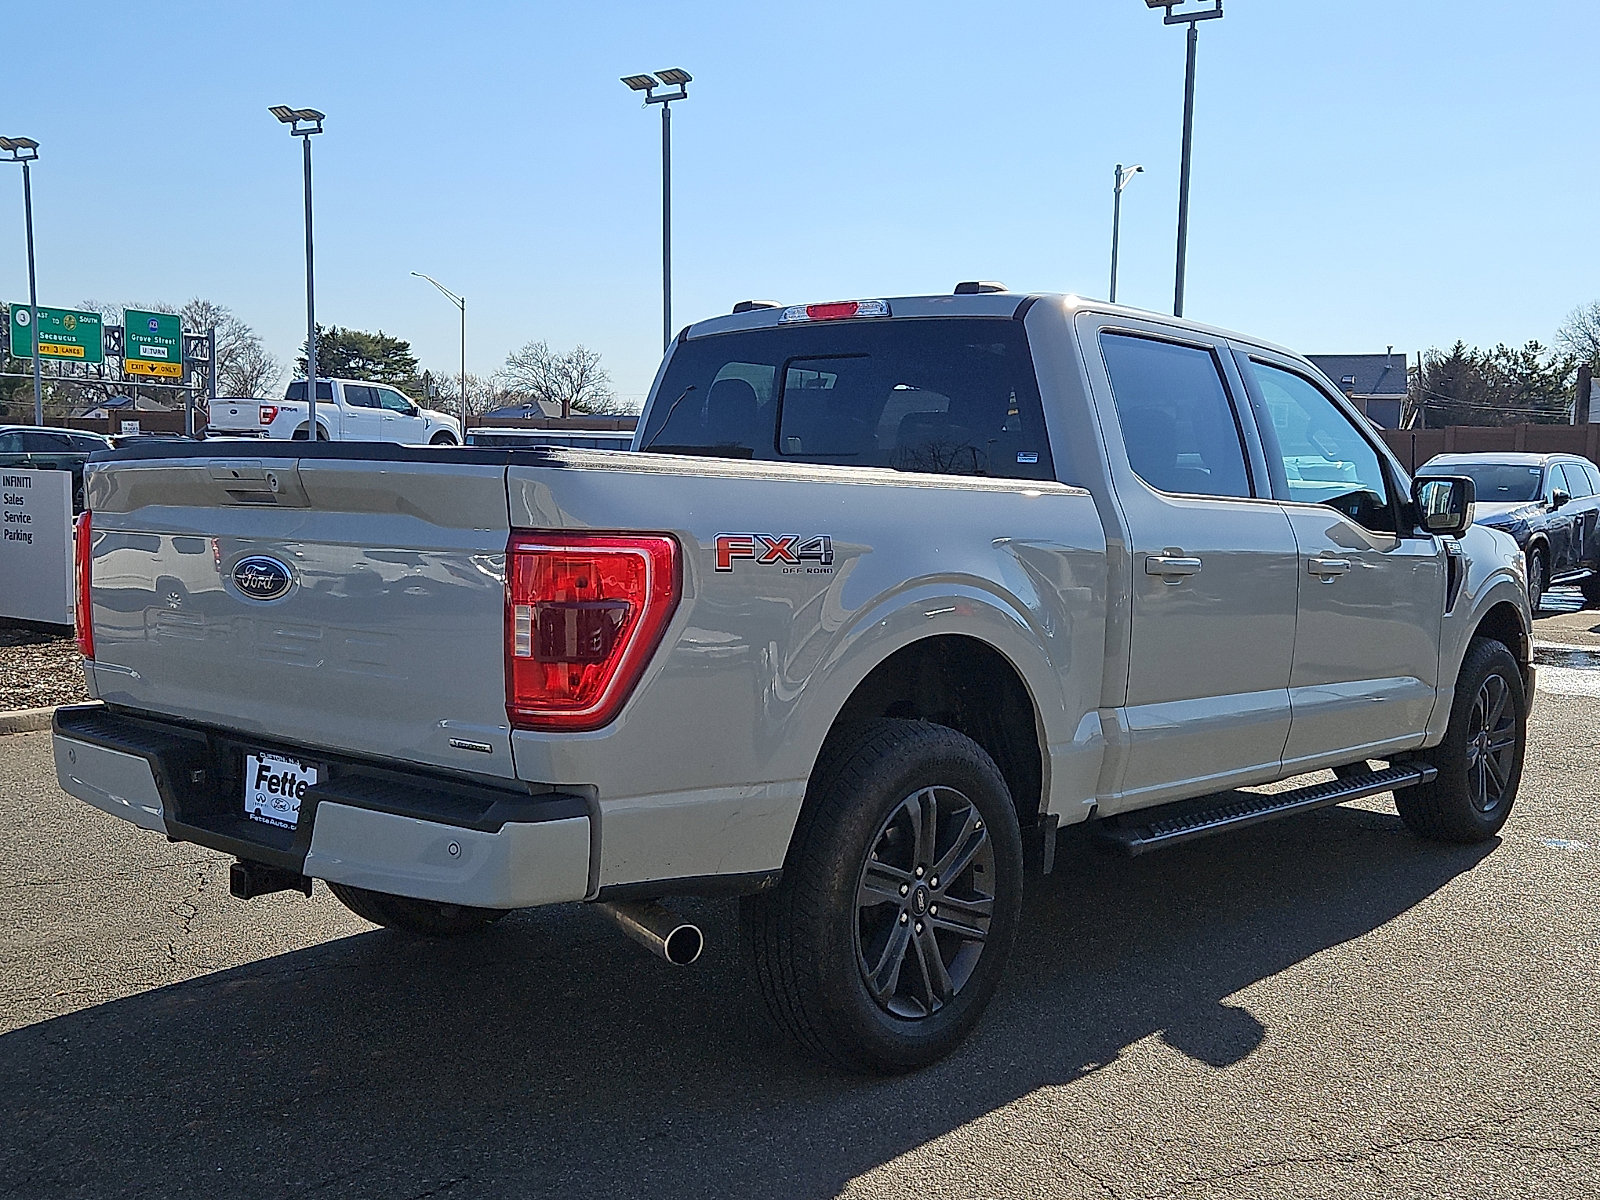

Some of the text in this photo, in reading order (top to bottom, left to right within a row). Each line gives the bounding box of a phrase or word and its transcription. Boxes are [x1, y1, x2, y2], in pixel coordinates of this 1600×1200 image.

[19, 313, 27, 323] 3
[51, 317, 60, 325] TO
[79, 315, 98, 324] SOUTH
[39, 331, 77, 342] Secaucus
[131, 333, 176, 345] Grove Street
[53, 345, 59, 354] 3
[61, 347, 81, 355] LANES
[2, 475, 32, 488] INFINITI
[3, 493, 24, 505] Sales
[4, 511, 32, 524] Service
[4, 529, 33, 544] Parking
[713, 533, 834, 572] FX4
[237, 564, 276, 590] Ford
[254, 763, 309, 800] Fette
